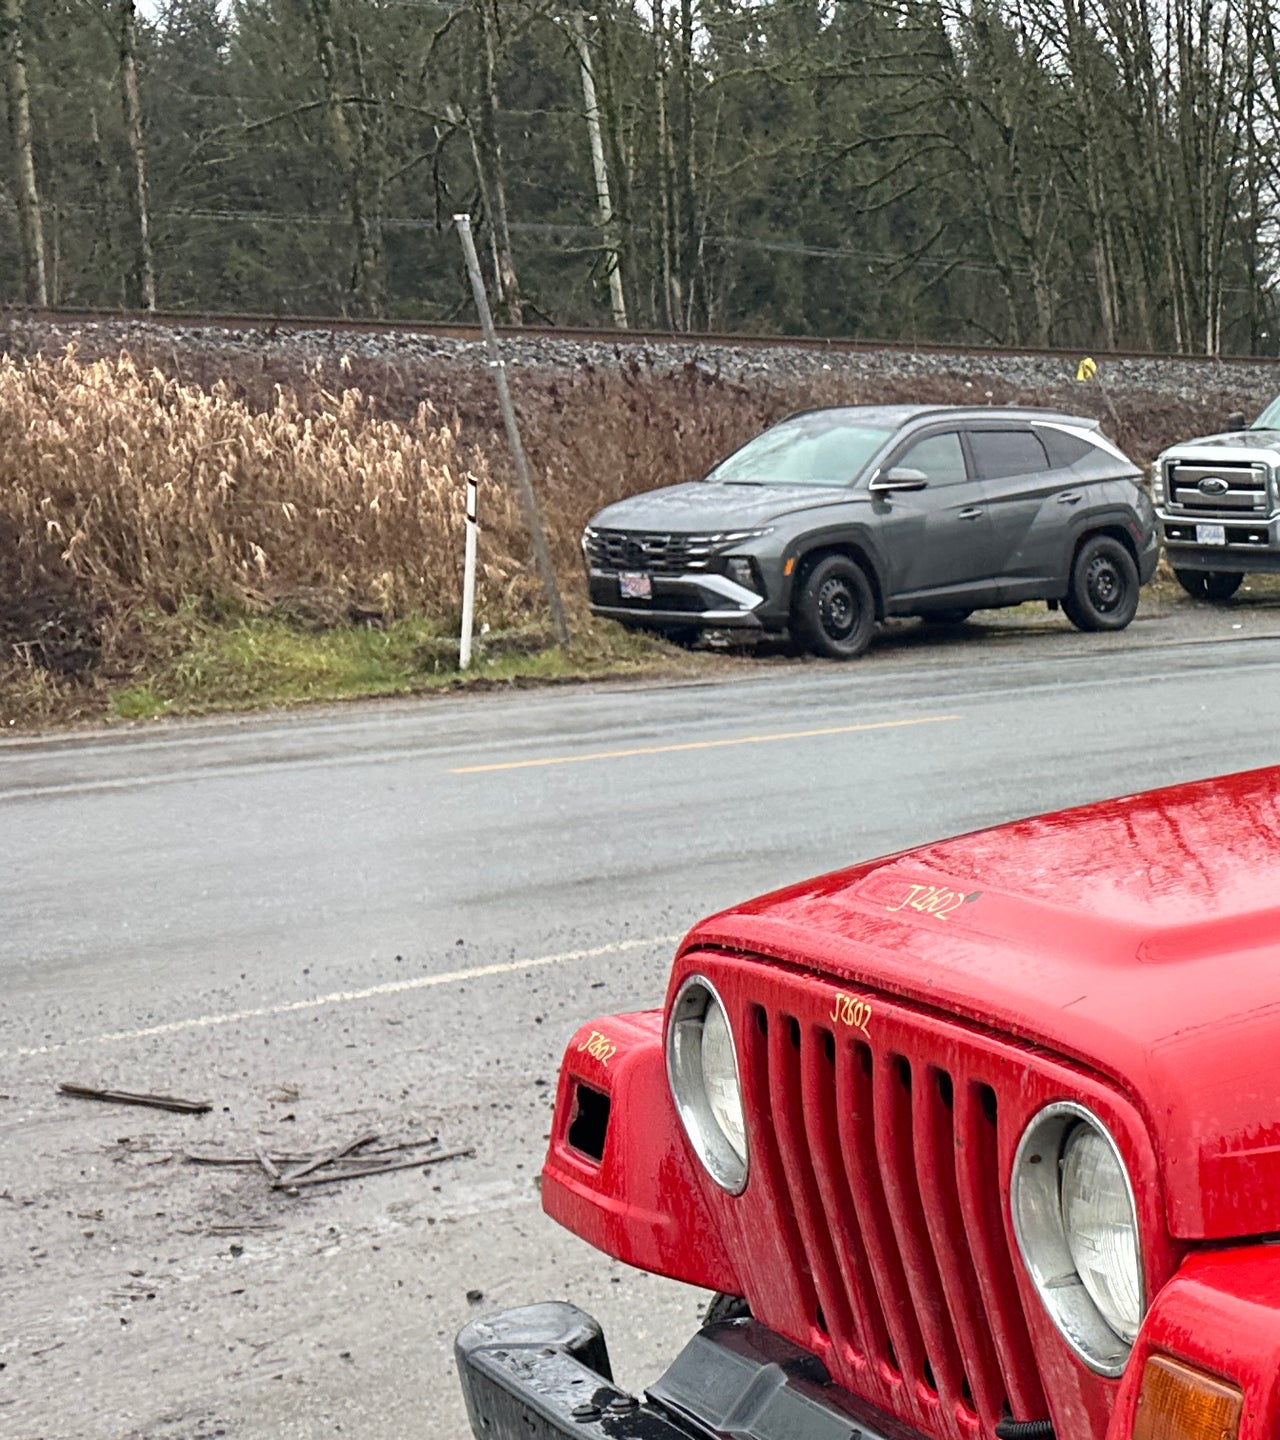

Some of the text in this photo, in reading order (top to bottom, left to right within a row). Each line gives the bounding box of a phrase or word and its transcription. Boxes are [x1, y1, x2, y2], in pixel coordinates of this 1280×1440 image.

[886, 883, 965, 921] J2602
[829, 993, 872, 1040] J2602
[577, 1030, 617, 1067] J2602
